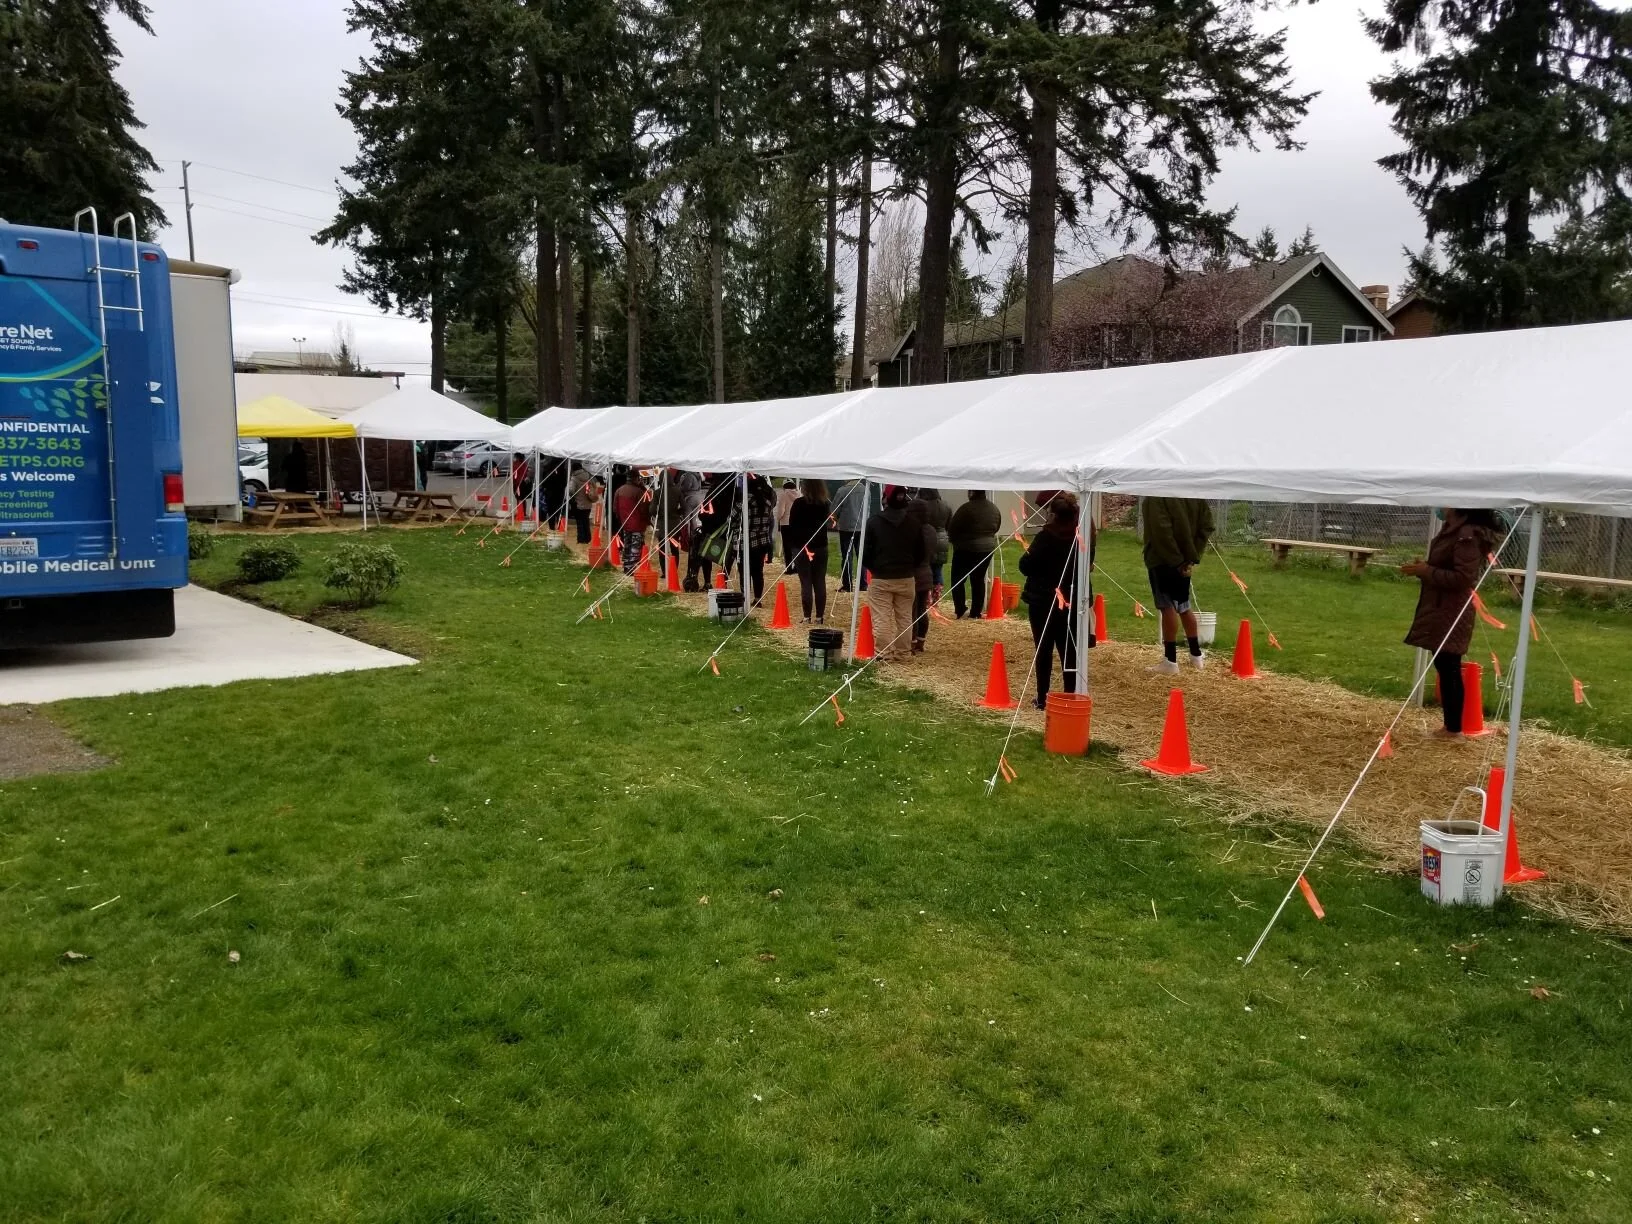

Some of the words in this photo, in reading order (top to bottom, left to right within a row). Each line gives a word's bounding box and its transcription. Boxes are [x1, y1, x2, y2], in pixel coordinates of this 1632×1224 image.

[11, 471, 75, 481] Welcome
[17, 490, 55, 499] Testing
[0, 511, 54, 519] ltrasounds
[0, 560, 38, 574] bile
[45, 558, 115, 572] Medical
